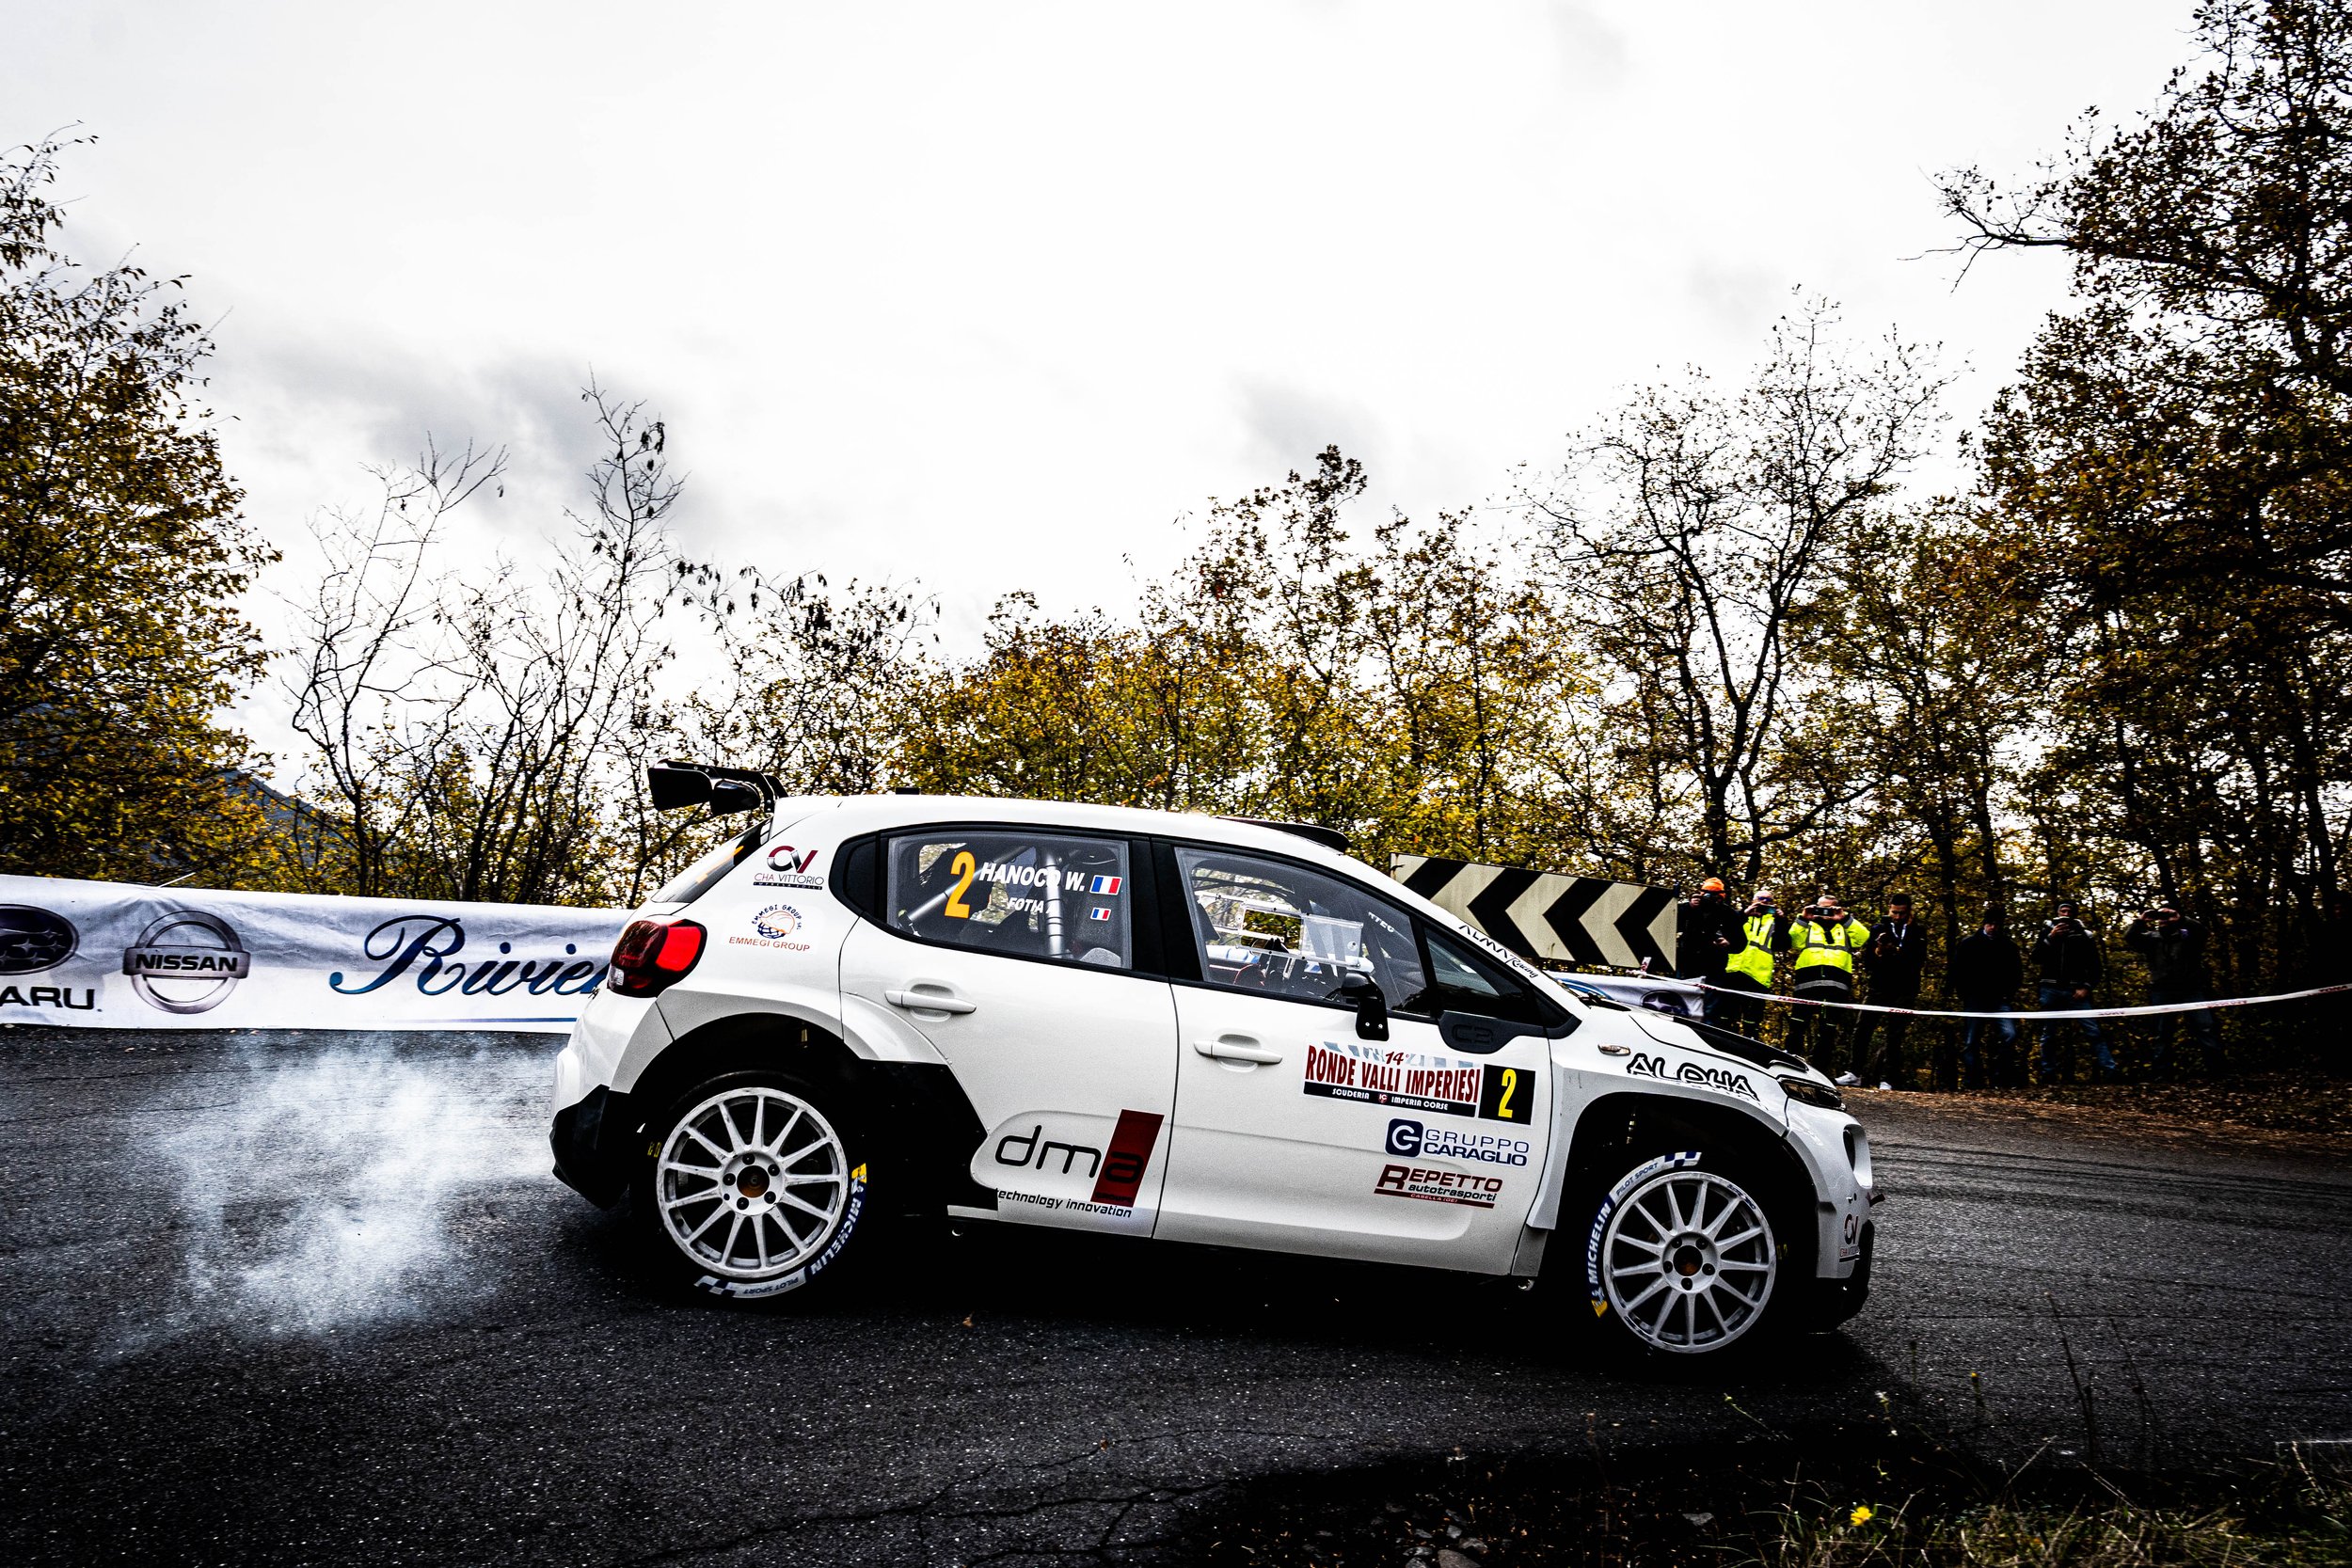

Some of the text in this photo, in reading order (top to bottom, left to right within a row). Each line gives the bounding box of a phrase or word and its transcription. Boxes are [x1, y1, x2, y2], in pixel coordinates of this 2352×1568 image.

[767, 846, 818, 874] CV
[754, 872, 825, 886] CHA VITTORIO
[944, 850, 976, 919] 2
[1065, 871, 1087, 892] W.
[751, 904, 778, 925] EMMEGI
[782, 904, 803, 920] GROUP
[1007, 896, 1044, 914] FOTIA
[728, 936, 810, 952] EMMEGI GROUP
[135, 954, 238, 973] NISSAN
[1305, 1044, 1481, 1103] RONDE VALLI IMPERIESI
[1332, 1087, 1370, 1100] SCUDERIA
[1391, 1096, 1422, 1107] IMPERIA
[1423, 1101, 1449, 1111] CORSE
[1498, 1068, 1517, 1118] 2
[1425, 1129, 1530, 1153] GRUPPO
[994, 1124, 1144, 1183] dma
[1423, 1142, 1528, 1166] CARAGLIO
[1376, 1164, 1503, 1193] REPETTO
[1615, 1162, 1659, 1196] PILOT SPORT
[995, 1187, 1132, 1218] technology innovation
[1407, 1184, 1498, 1202] autotrasporti
[1410, 1193, 1442, 1201] CASELLA
[810, 1196, 862, 1275] MICHELIN
[1587, 1201, 1612, 1285] MICHELIN
[742, 1276, 799, 1295] PILOT SPORT
